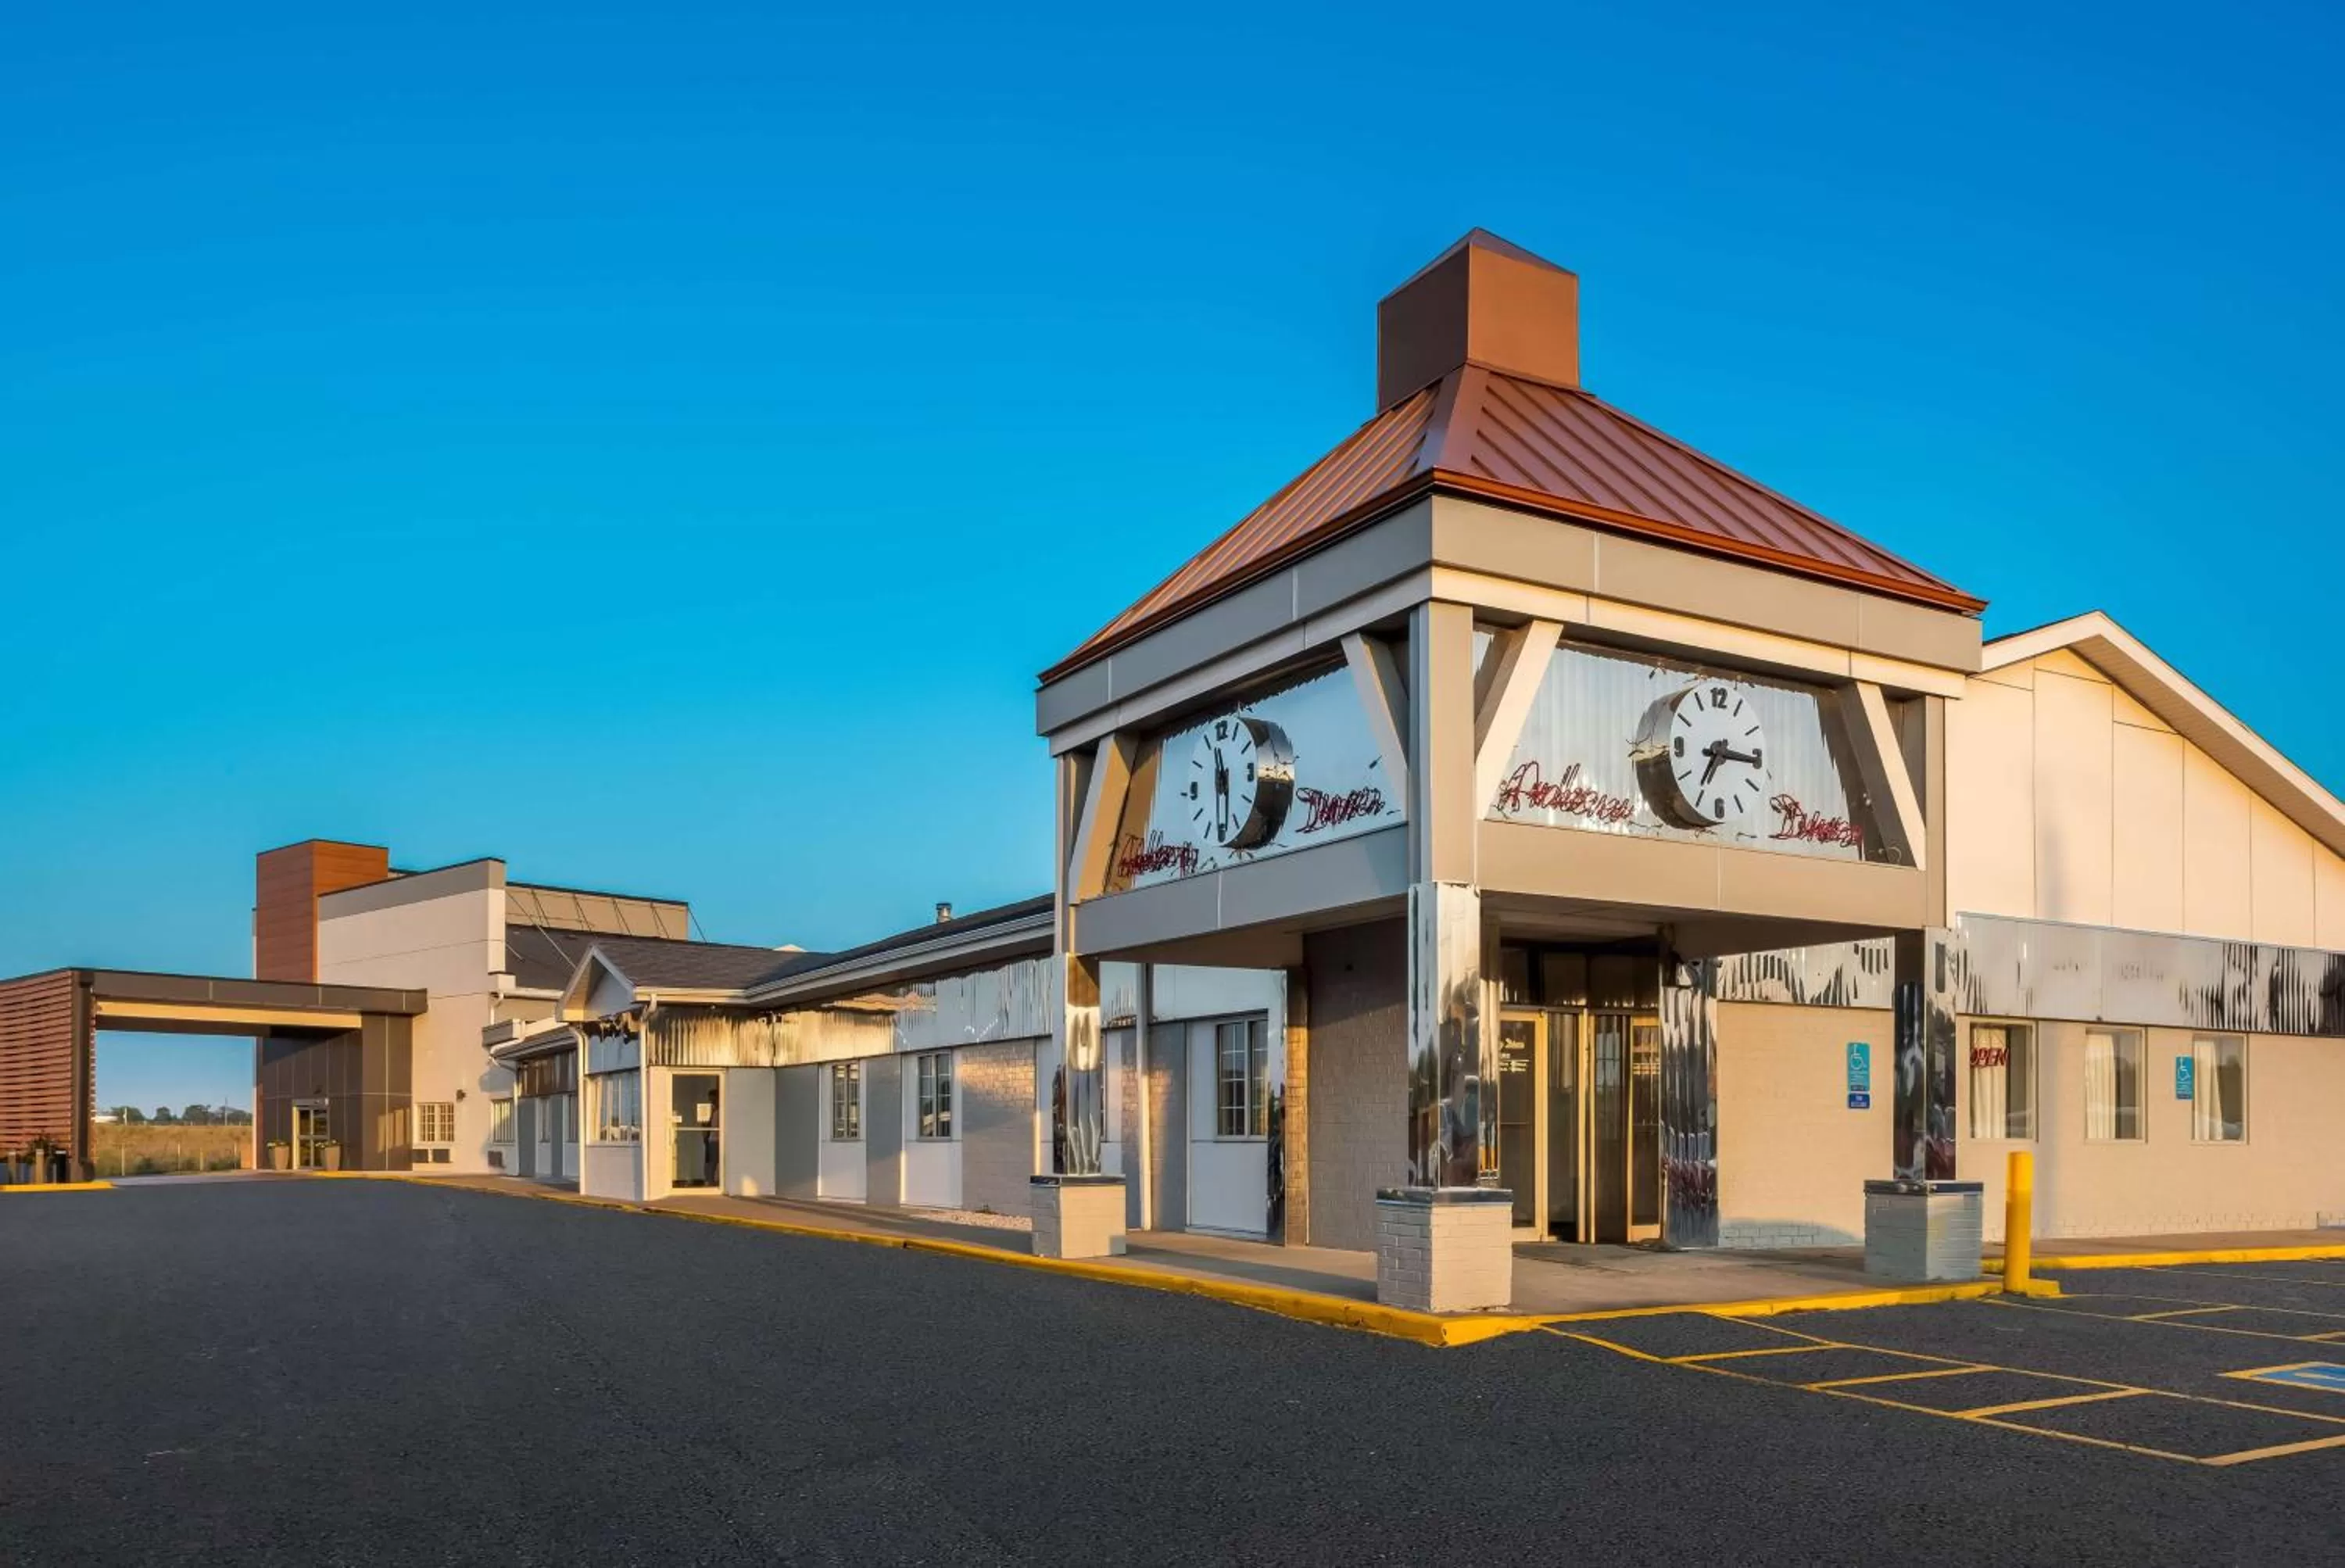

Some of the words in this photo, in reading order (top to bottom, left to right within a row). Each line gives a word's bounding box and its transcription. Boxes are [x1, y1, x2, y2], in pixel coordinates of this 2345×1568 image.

[1710, 687, 1728, 710] 12
[1215, 720, 1228, 742] 12
[1674, 736, 1684, 757] 9
[1752, 748, 1763, 770] 3
[1247, 762, 1255, 782] 3
[1190, 781, 1198, 801] 9
[1714, 797, 1725, 819] 6
[1970, 1047, 2009, 1068] OPEN
